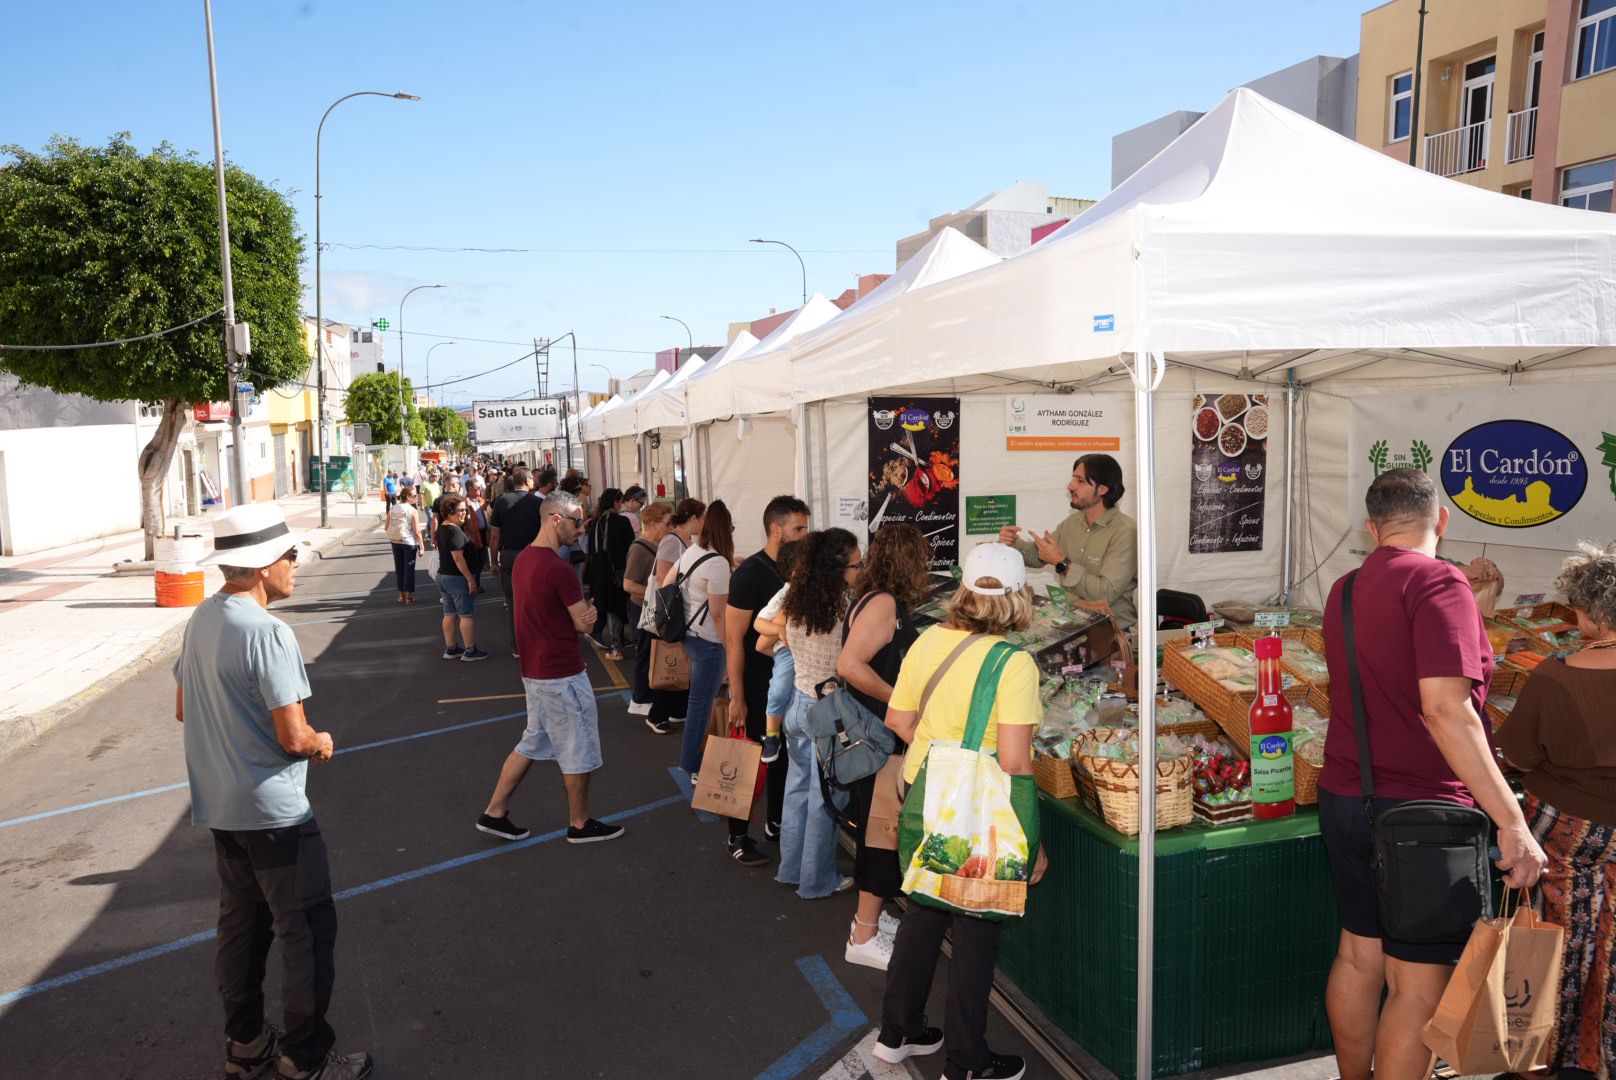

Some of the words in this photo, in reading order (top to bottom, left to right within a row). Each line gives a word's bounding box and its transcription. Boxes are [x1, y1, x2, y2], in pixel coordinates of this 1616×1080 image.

[478, 408, 517, 418] Santa
[521, 404, 557, 416] Lucía
[1068, 409, 1103, 418] GONZÁLEZ
[1051, 418, 1089, 427] RODRÍGUEZ
[1449, 448, 1473, 473] El
[1489, 475, 1508, 485] desde
[1509, 477, 1529, 486] 1995
[1229, 483, 1263, 494] Condimentos
[880, 513, 906, 526] specias
[915, 511, 956, 522] Condimentos
[1468, 504, 1496, 522] Especias
[1504, 511, 1554, 525] Condimentos
[930, 535, 955, 551] Spices
[926, 554, 955, 570] fusions
[1270, 766, 1292, 775] Picante
